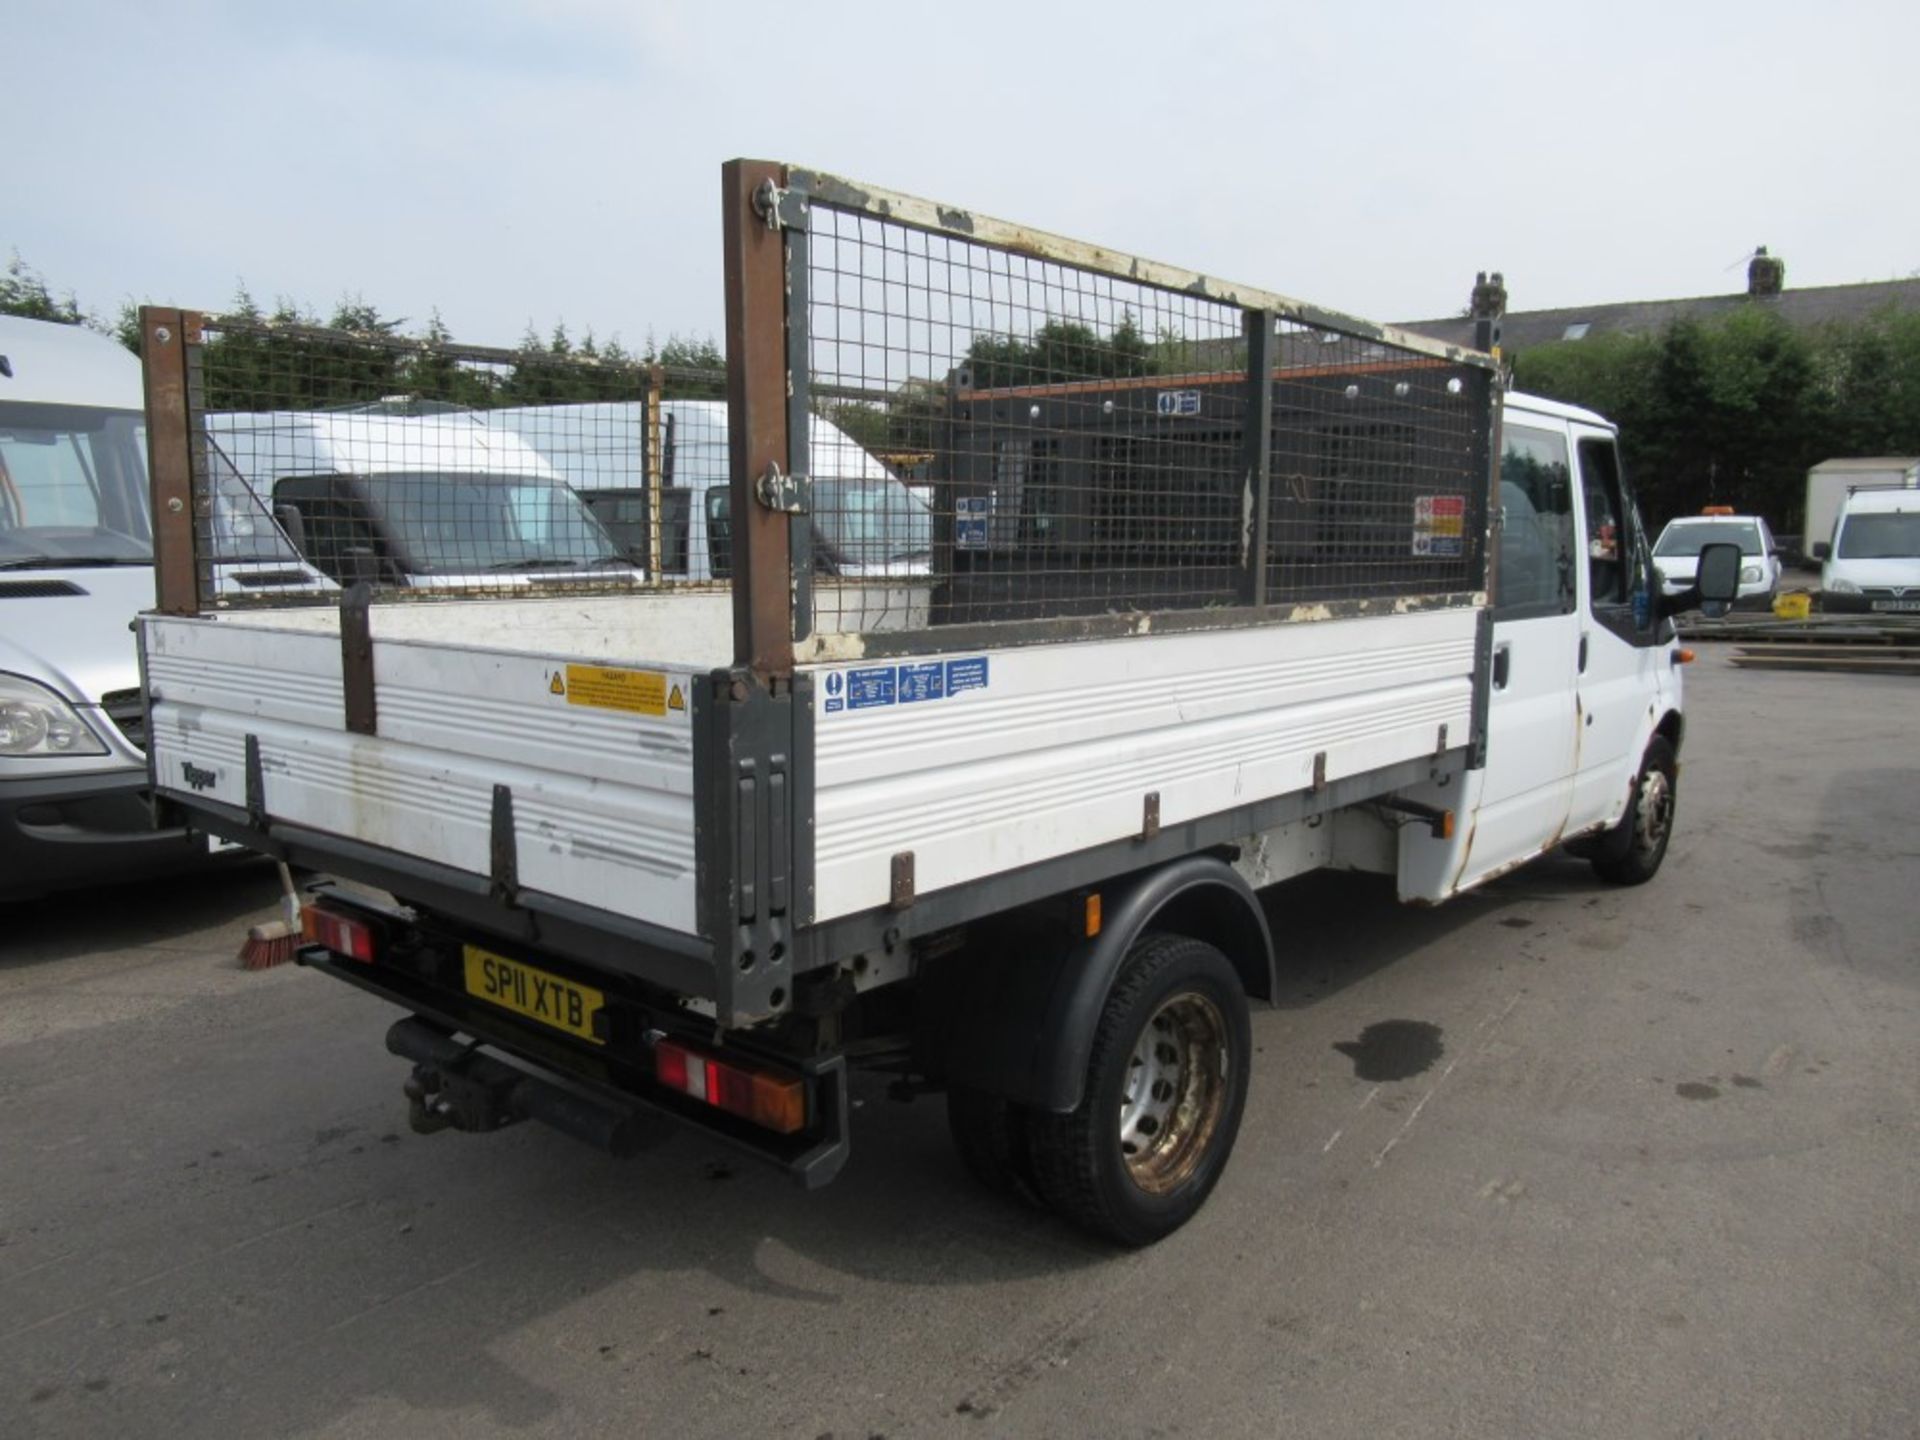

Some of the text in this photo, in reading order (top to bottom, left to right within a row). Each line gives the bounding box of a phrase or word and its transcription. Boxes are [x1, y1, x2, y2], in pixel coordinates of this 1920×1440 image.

[181, 761, 216, 791] Tipper
[482, 958, 583, 1028] SP11 XTB
